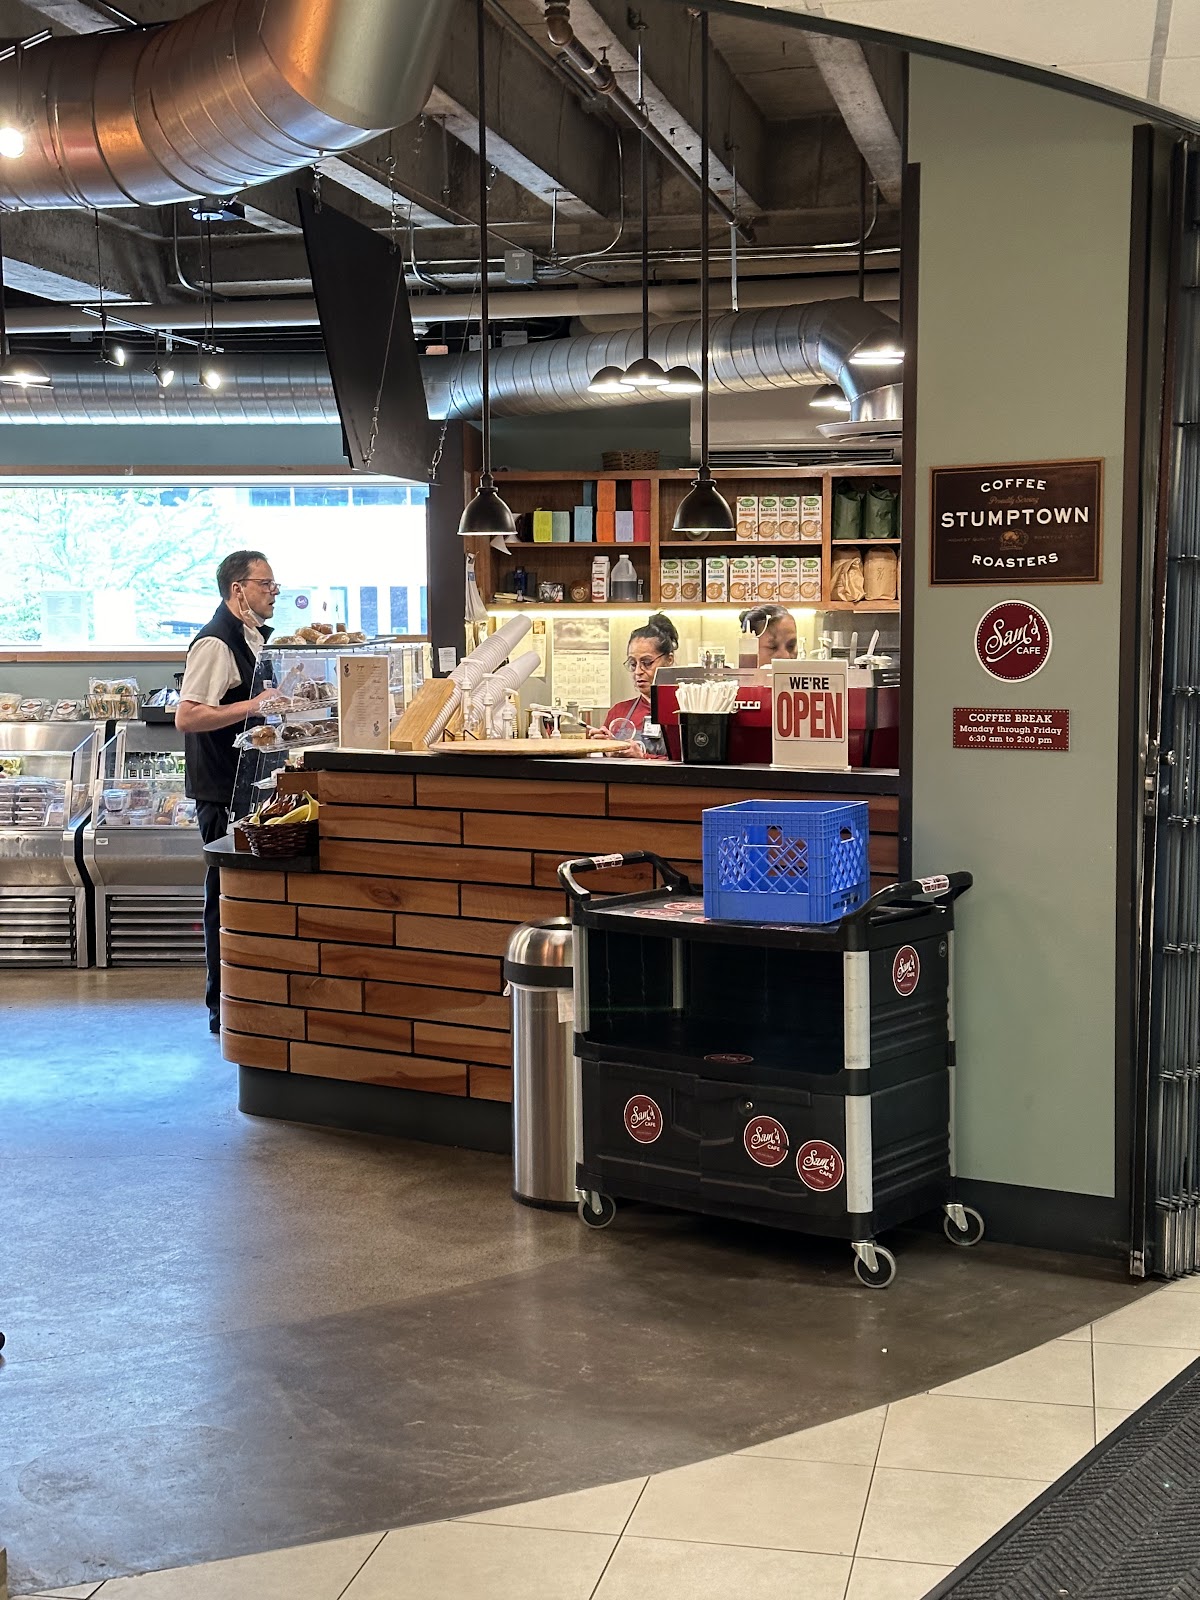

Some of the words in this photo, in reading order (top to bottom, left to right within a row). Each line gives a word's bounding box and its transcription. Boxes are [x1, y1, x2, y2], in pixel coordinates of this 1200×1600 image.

[980, 478, 1047, 493] COFFEE
[941, 506, 1089, 528] STUMPTOWN
[971, 552, 1059, 568] ROASTERS
[985, 614, 1041, 663] Sam's
[1016, 646, 1041, 655] CAFE
[789, 676, 830, 690] WE'RE
[777, 691, 843, 739] OPEN
[968, 713, 1012, 723] COFFEE
[1014, 713, 1053, 723] BREAK
[959, 725, 995, 734] Monday
[997, 725, 1031, 735] through
[1033, 726, 1063, 736] Friday
[1005, 735, 1015, 743] to
[1016, 735, 1036, 743] 2:00
[1037, 737, 1053, 745] pm
[630, 1105, 656, 1129] Sam's
[750, 1126, 781, 1150] Sam's
[767, 1143, 781, 1152] CAFE
[802, 1149, 836, 1171] Sam's
[818, 1168, 834, 1180] CAFE
